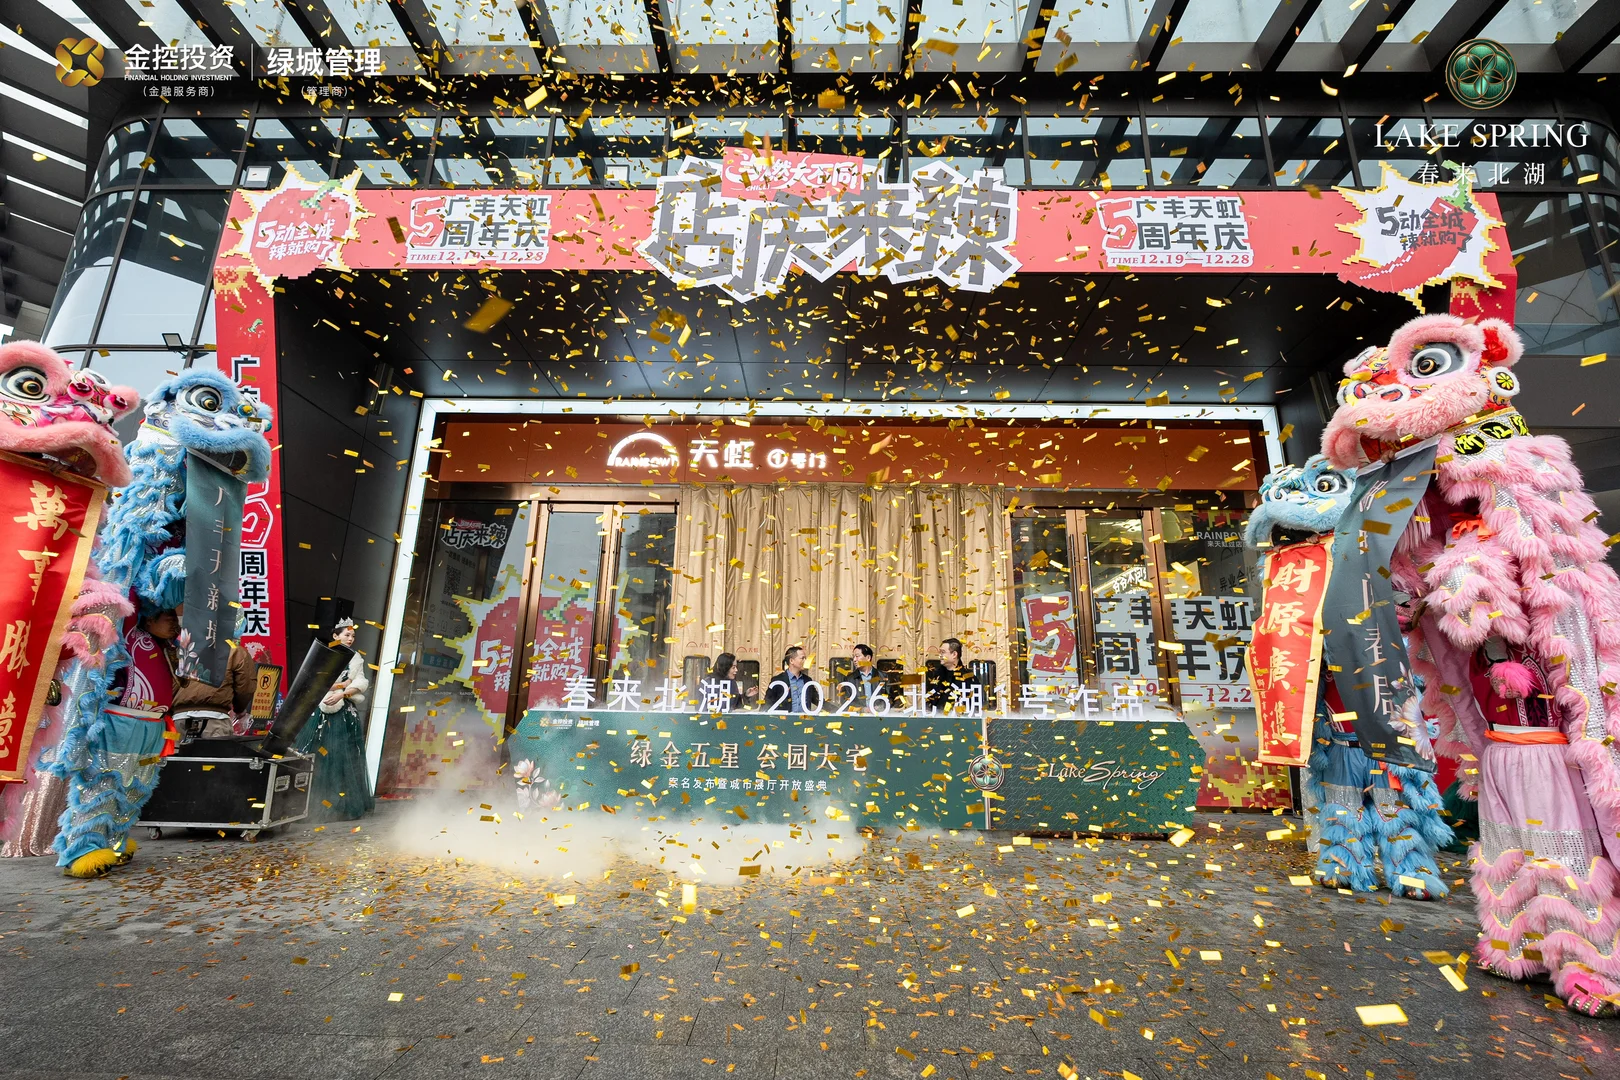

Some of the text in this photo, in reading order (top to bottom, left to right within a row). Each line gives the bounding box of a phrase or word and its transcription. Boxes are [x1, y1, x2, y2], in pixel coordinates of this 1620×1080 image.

[447, 197, 548, 217] 广丰天虹
[1136, 199, 1241, 219] 广丰天虹
[1376, 205, 1467, 237] 5动全城
[255, 219, 336, 248] 5动全城
[440, 220, 546, 248] 周年庆
[1137, 222, 1248, 250] 周年庆
[1400, 231, 1473, 253] 辣就购了
[269, 240, 336, 261] 辣就购了
[690, 439, 755, 468] 天虹
[240, 551, 268, 635] 周年庆
[563, 675, 731, 714] 春来北湖
[630, 740, 868, 772] 绿金五星 公园大宅
[668, 777, 828, 792] 案名发布暨城市展厅开放盛典
[1048, 760, 1165, 790] Lake Spring
